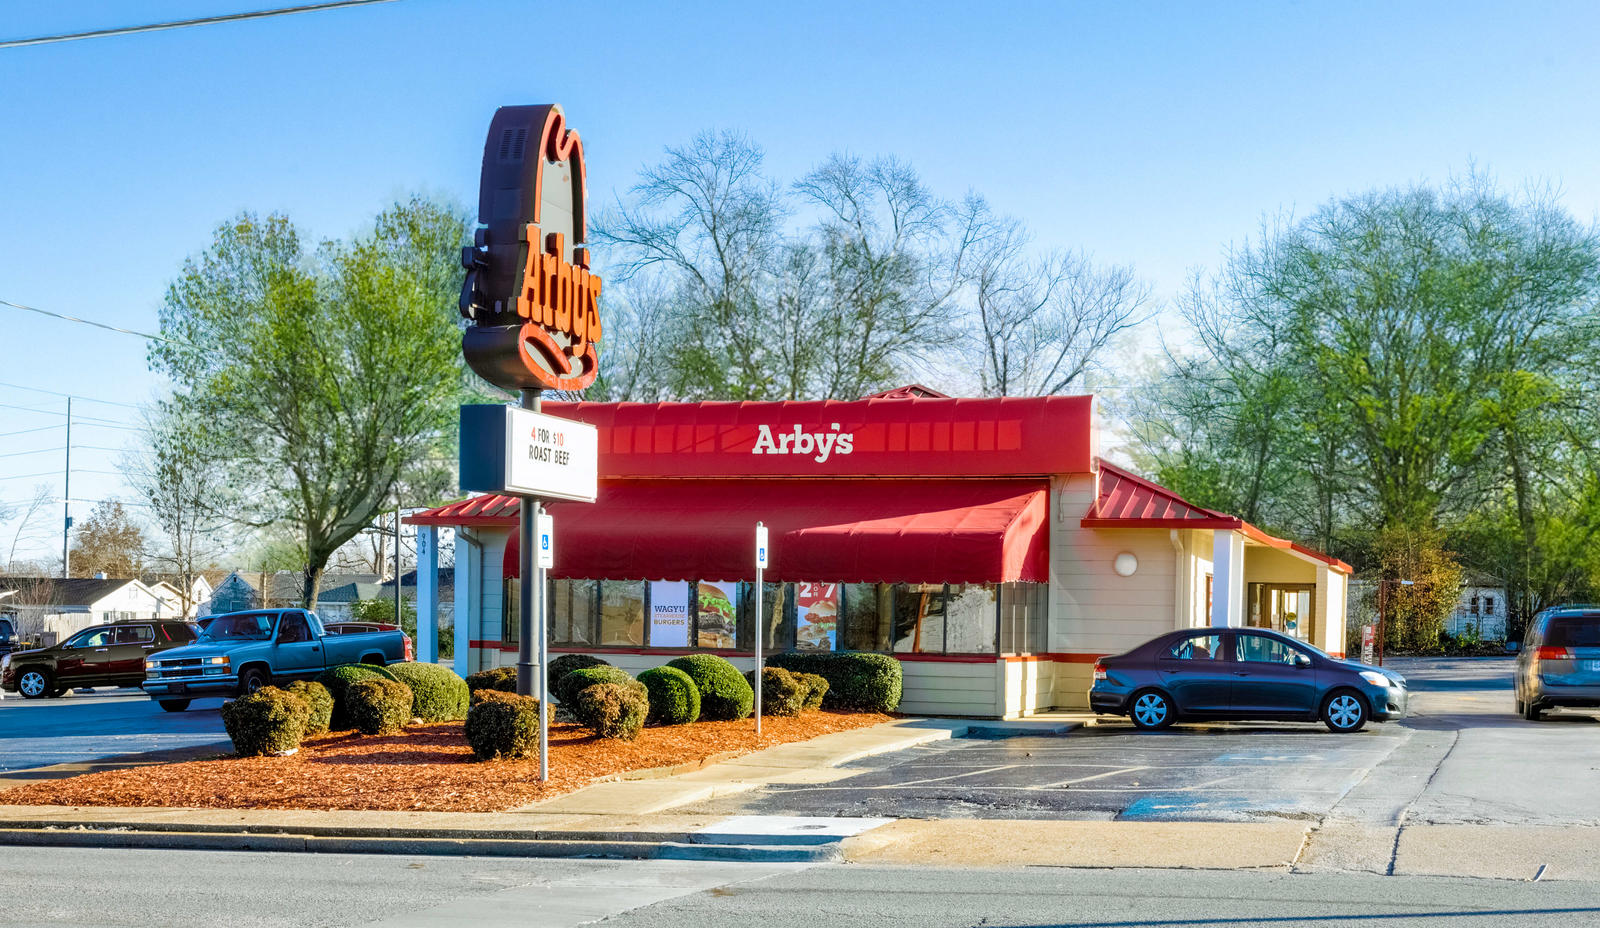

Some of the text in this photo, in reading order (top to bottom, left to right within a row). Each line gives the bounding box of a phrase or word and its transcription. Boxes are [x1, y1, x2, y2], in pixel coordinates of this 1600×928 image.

[517, 224, 602, 357] Arby's
[531, 426, 564, 447] 4 FOR $10
[752, 423, 853, 463] Arby's
[529, 444, 570, 465] ROAST BEEF
[800, 582, 812, 598] 2
[654, 605, 685, 613] WAGYU
